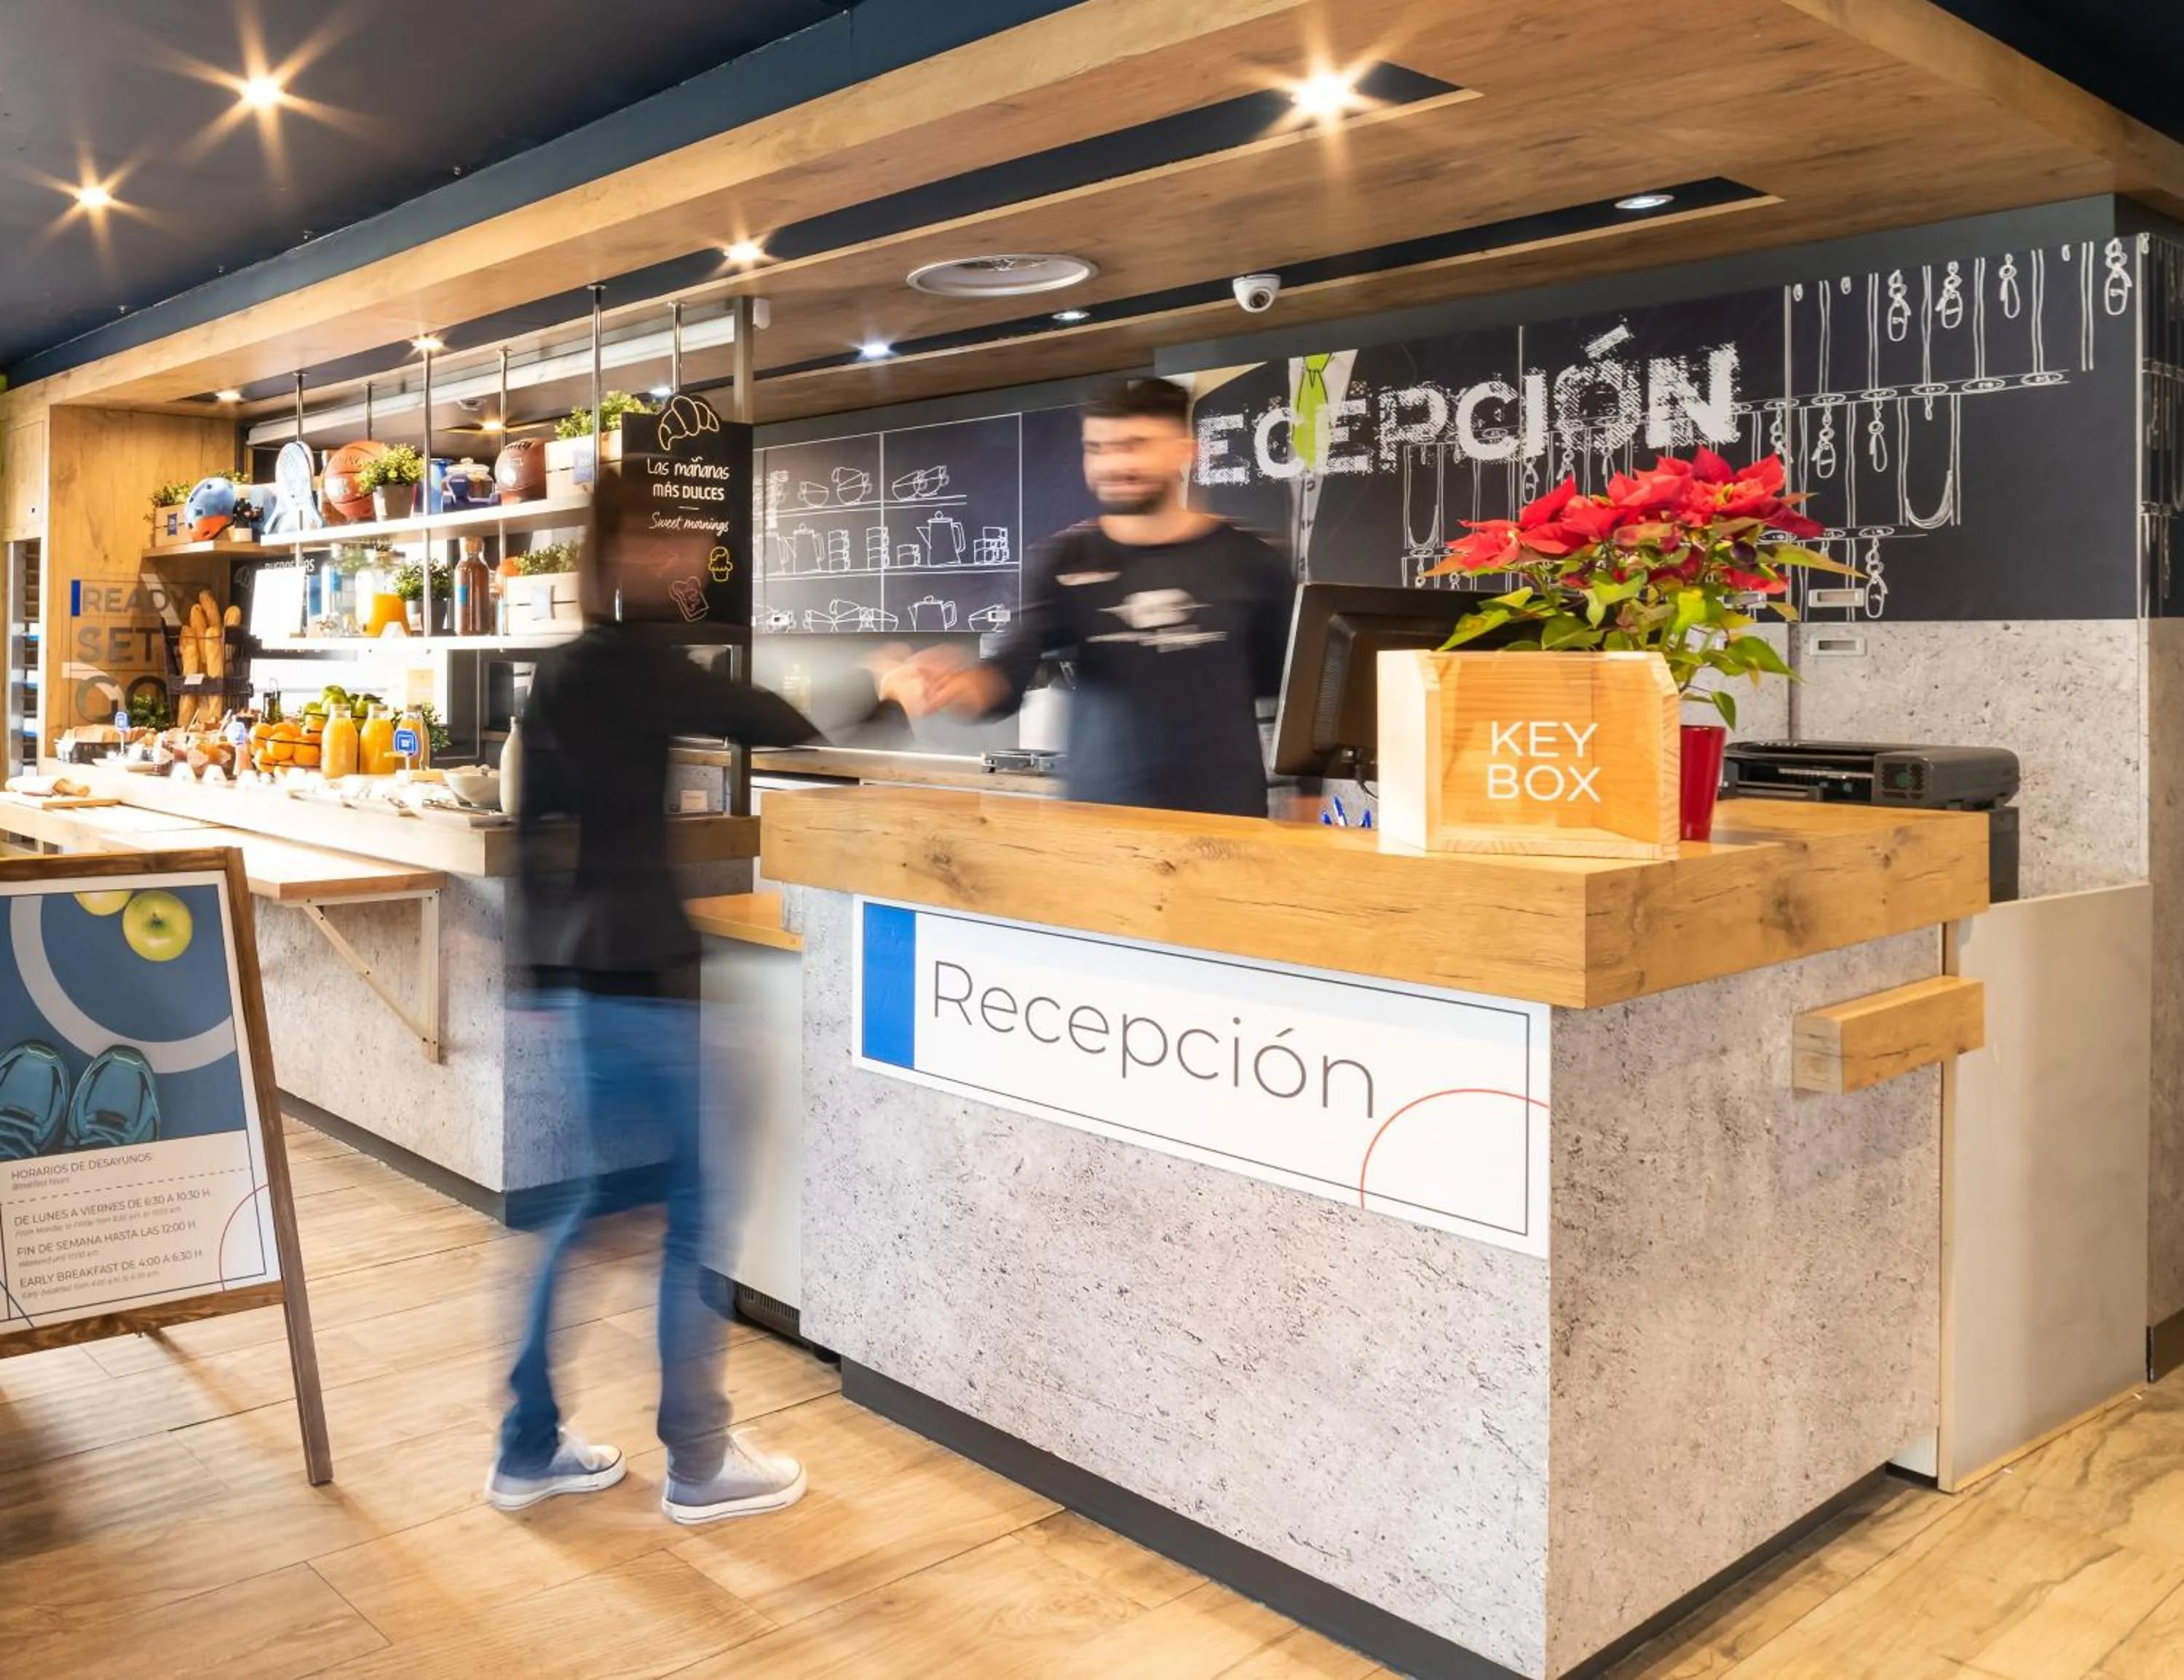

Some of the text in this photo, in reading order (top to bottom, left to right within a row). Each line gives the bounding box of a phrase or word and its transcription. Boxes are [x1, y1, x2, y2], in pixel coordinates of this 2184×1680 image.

[1195, 316, 1742, 488] ECEPCIÓN
[647, 456, 729, 480] Las mañanas
[653, 481, 725, 501] MÁS DULCES
[648, 512, 729, 536] Sweet mornings
[76, 627, 163, 662] SET
[1490, 721, 1599, 758] KEY
[1487, 764, 1602, 803] BOX
[933, 959, 1374, 1120] Recepción
[11, 1153, 152, 1180] HORARIOS DE DESAYUNOS
[14, 1216, 30, 1227] DE
[33, 1209, 68, 1224] LUNES
[71, 1208, 79, 1218] A
[79, 1201, 125, 1216] VIERNES
[127, 1198, 143, 1210] DE
[167, 1193, 175, 1203] A
[202, 1188, 210, 1197] H
[17, 1220, 195, 1256] FIN DE SEMANA HASTA LAS 12:00 H
[20, 1274, 55, 1288] EARLY
[57, 1262, 117, 1283] BREAKFAST
[122, 1260, 135, 1271] DE
[162, 1254, 170, 1264] A
